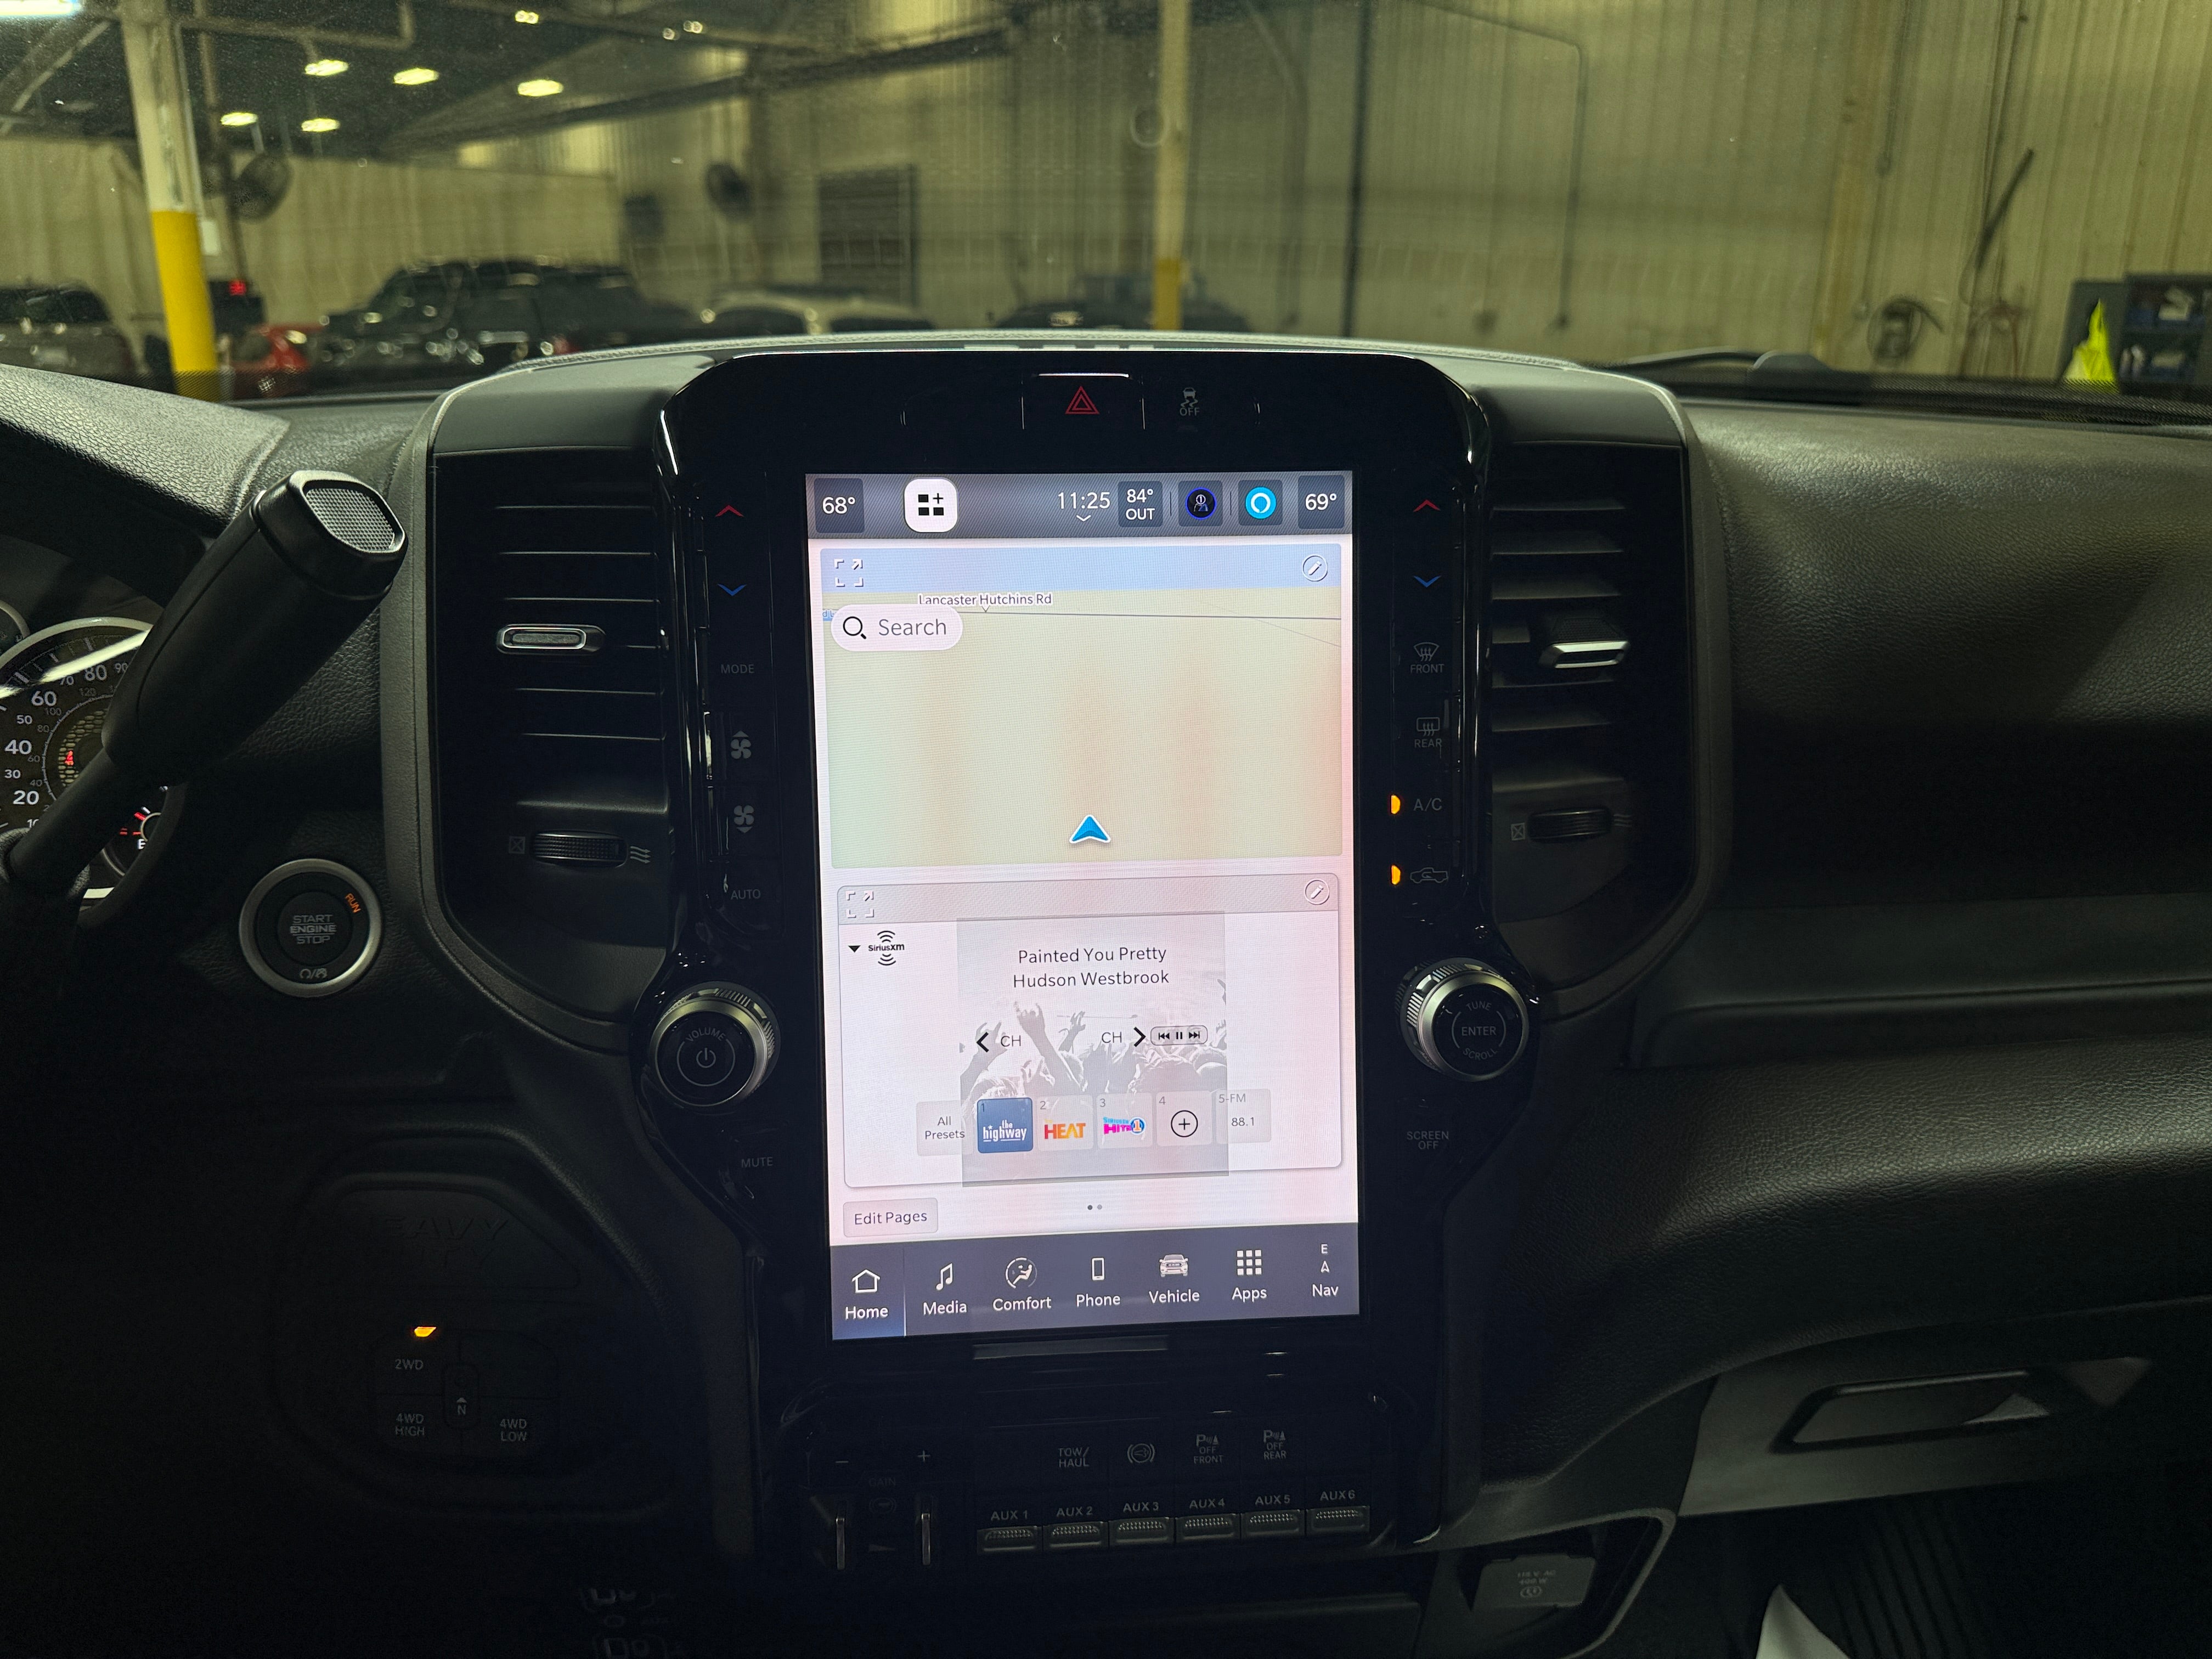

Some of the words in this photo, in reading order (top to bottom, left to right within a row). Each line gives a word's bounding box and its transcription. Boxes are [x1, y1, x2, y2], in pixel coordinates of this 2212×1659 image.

[1180, 407, 1199, 416] OFF
[1058, 492, 1110, 510] 11:25
[1126, 488, 1154, 503] 84°
[822, 497, 855, 514] 68°
[1305, 493, 1337, 510] 69°
[1126, 508, 1155, 521] OUT
[919, 594, 977, 606] Lancaster
[980, 594, 1033, 605] Hutchins
[1036, 594, 1052, 605] Rd
[878, 618, 947, 636] Search
[84, 664, 108, 681] 80
[720, 664, 755, 674] MODE
[1410, 663, 1444, 673] FRONT
[31, 690, 57, 707] 60
[44, 707, 62, 716] 100
[16, 714, 33, 725] 50
[37, 724, 50, 733] 80
[4, 740, 32, 755] 40
[1414, 738, 1442, 748] REAR
[4, 769, 21, 779] 30
[30, 779, 43, 787] 40
[13, 790, 40, 805] 20
[1413, 798, 1442, 811] A/C
[137, 838, 146, 850] E
[730, 889, 761, 901] AUTO
[345, 893, 362, 913] RUN
[294, 914, 334, 924] START
[290, 924, 337, 933] ENGINE
[297, 935, 331, 944] STOP
[1018, 949, 1079, 963] Painted
[1082, 949, 1114, 962] You
[1119, 946, 1167, 963] Pretty
[1013, 973, 1076, 989] Hudson
[1081, 970, 1170, 986] Westbrook
[1466, 1000, 1492, 1012] TUNE
[686, 1027, 725, 1042] VOLUME
[1462, 1026, 1497, 1036] ENTER
[1000, 1035, 1022, 1048] CH
[1101, 1031, 1123, 1044] CH
[1463, 1047, 1498, 1060] SCROLL
[1099, 1098, 1106, 1108] 3
[1159, 1096, 1166, 1105] 4
[1218, 1093, 1246, 1104] 5-FM
[981, 1103, 985, 1112] 1
[1040, 1101, 1046, 1110] 2
[937, 1116, 951, 1127] All
[1001, 1119, 1013, 1128] the
[1231, 1116, 1255, 1127] 88.1
[924, 1128, 965, 1140] Presets
[983, 1125, 1028, 1142] highway
[1044, 1122, 1086, 1139] HEAT
[1406, 1130, 1449, 1141] SCREEN
[1418, 1141, 1438, 1150] OFF
[741, 1156, 774, 1169] MUTE
[854, 1212, 883, 1225] Edit
[886, 1211, 928, 1226] Pages
[1321, 1244, 1328, 1254] E
[1232, 1286, 1267, 1302] Apps
[1312, 1284, 1339, 1297] Nav
[1076, 1292, 1121, 1307] Phone
[1149, 1289, 1200, 1304] Vehicle
[923, 1300, 968, 1314] Media
[993, 1295, 1052, 1311] Comfort
[845, 1304, 889, 1319] Home
[394, 1358, 424, 1370] 2WD
[456, 1404, 466, 1415] N
[396, 1413, 425, 1424] 4WD
[500, 1418, 527, 1429] 4WD
[395, 1426, 425, 1437] HIGH
[500, 1431, 528, 1442] LOW
[1058, 1446, 1090, 1458] TOW/
[1266, 1442, 1283, 1451] OFF
[1193, 1454, 1224, 1464] FRONT
[1263, 1450, 1287, 1460] REAR
[1058, 1458, 1090, 1468] HAUL
[1255, 1494, 1282, 1505] AUX
[1283, 1494, 1290, 1503] 5
[1319, 1491, 1346, 1502] AUX
[1348, 1489, 1356, 1499] 6
[1123, 1502, 1150, 1513] AUX
[1153, 1502, 1159, 1511] 3
[1189, 1498, 1216, 1509] AUX
[1217, 1498, 1226, 1507] 4
[991, 1510, 1019, 1521] AUX
[1023, 1510, 1028, 1519] 1
[1057, 1507, 1083, 1517] AUX
[1086, 1506, 1093, 1515] 2
